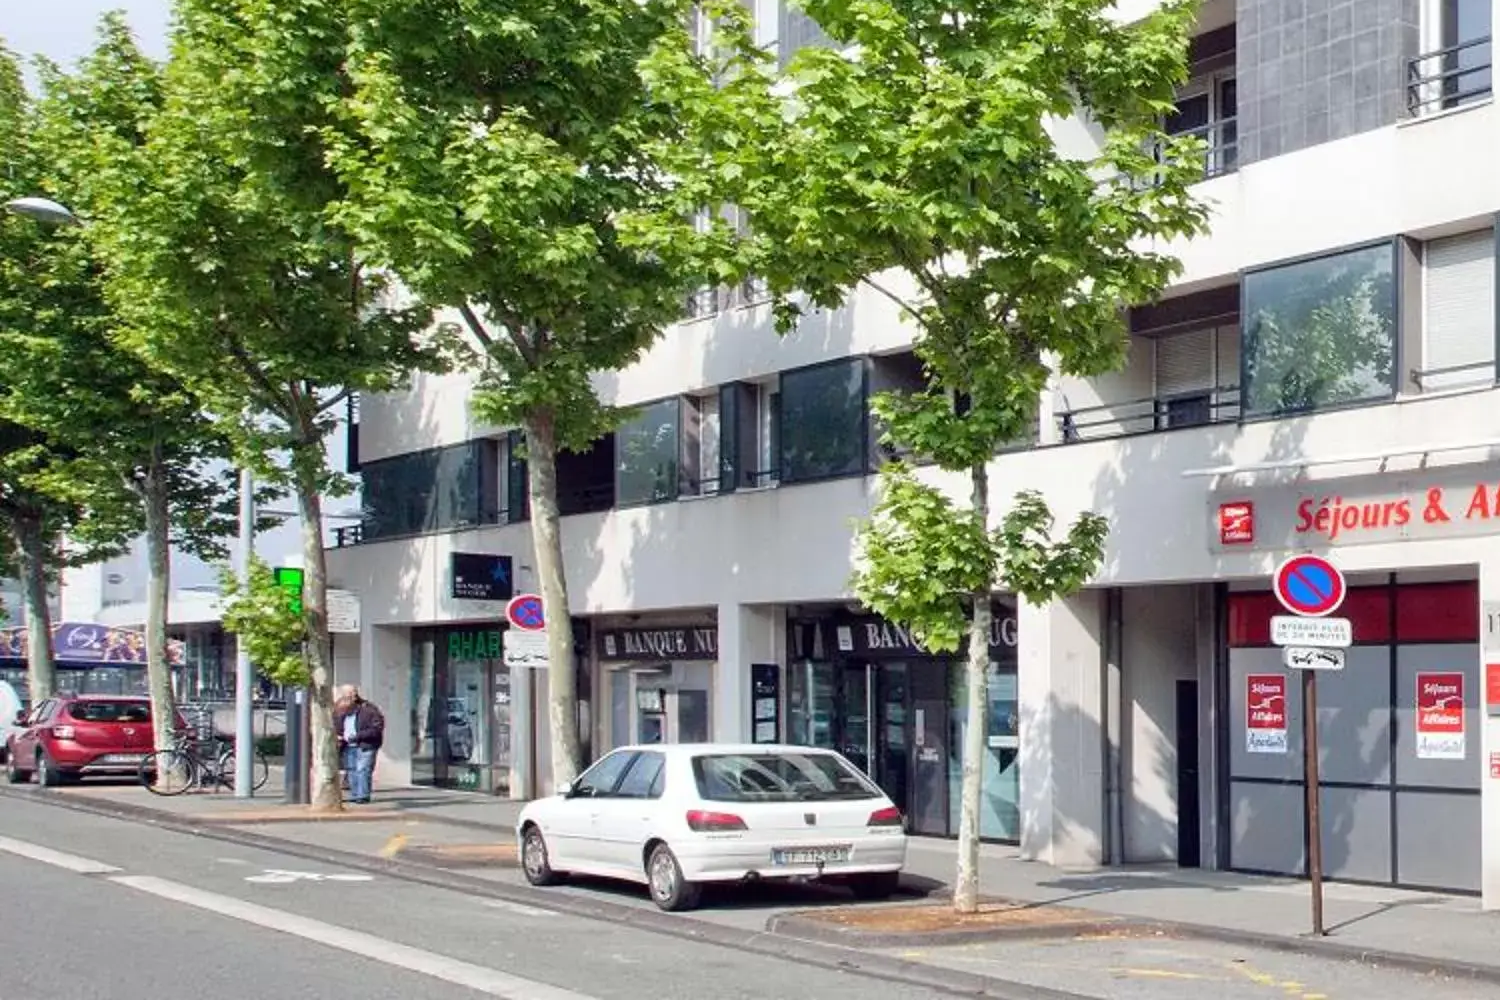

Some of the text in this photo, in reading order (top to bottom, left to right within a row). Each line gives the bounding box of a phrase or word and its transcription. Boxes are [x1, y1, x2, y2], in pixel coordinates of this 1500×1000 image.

[1296, 496, 1411, 541] Séjours
[1423, 487, 1450, 523] &
[623, 630, 687, 657] BANQUE
[863, 617, 927, 653] BANQ
[1423, 712, 1461, 725] Affaires
